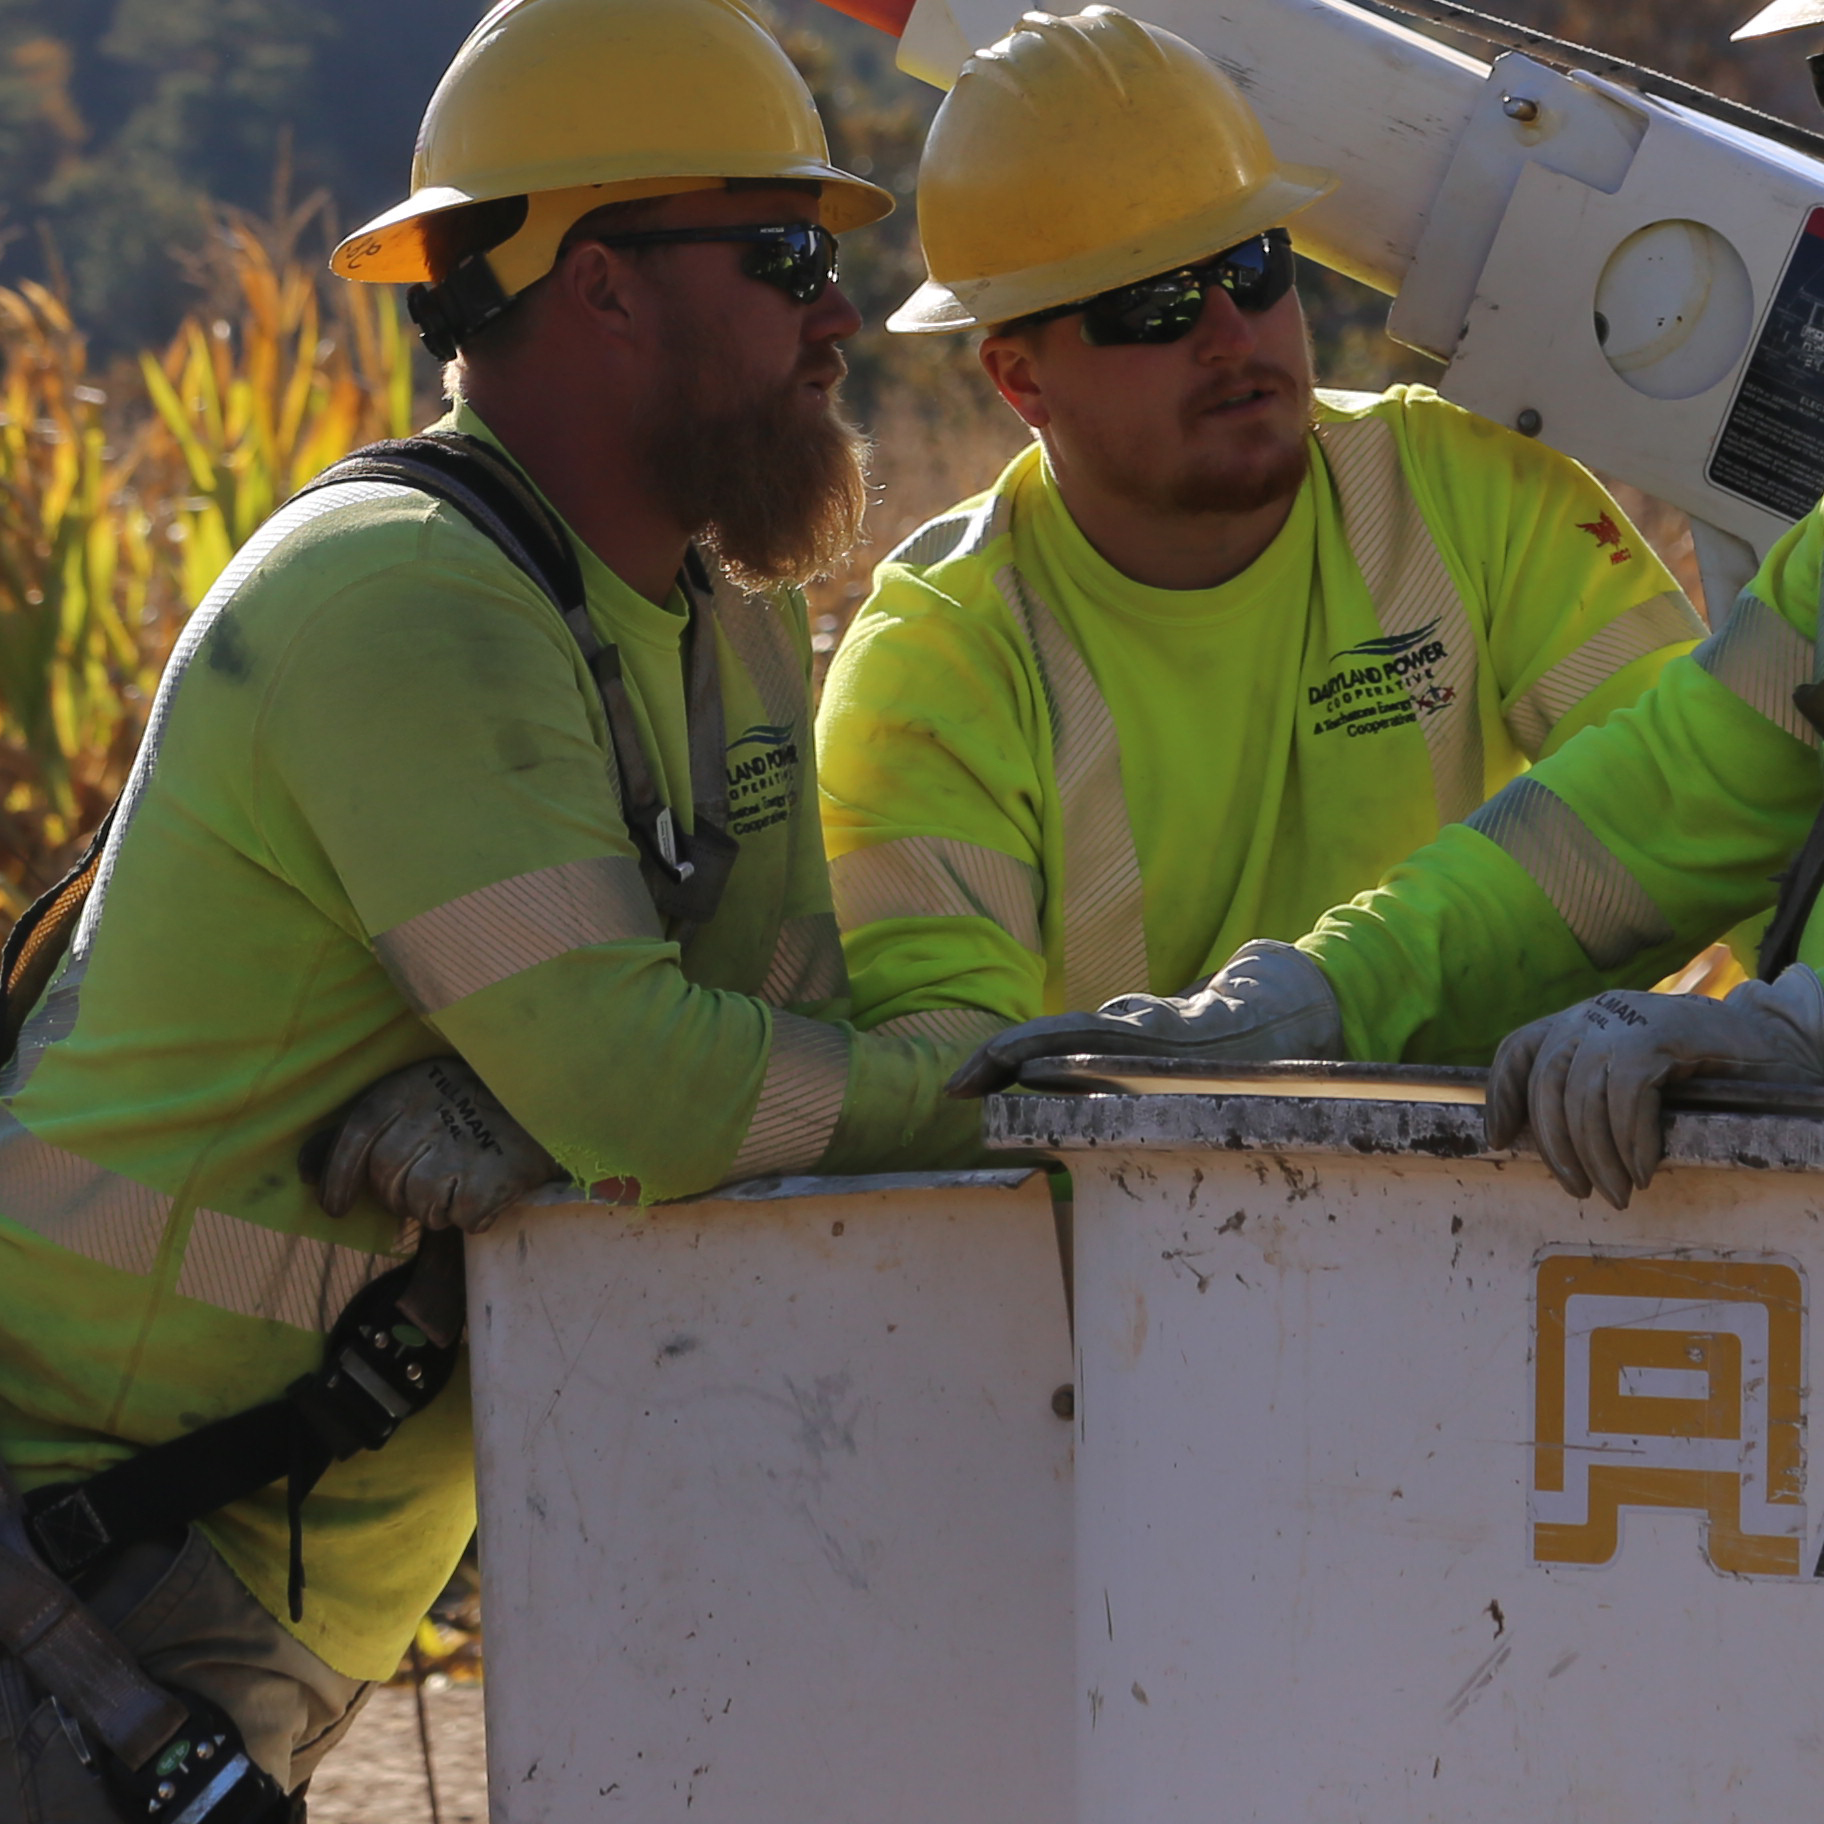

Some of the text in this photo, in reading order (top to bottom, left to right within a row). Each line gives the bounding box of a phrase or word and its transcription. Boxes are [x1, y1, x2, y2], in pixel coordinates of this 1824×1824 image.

[1383, 641, 1448, 680] POWER
[1326, 668, 1435, 712] COOPERATIVE
[1347, 712, 1417, 737] Cooperative
